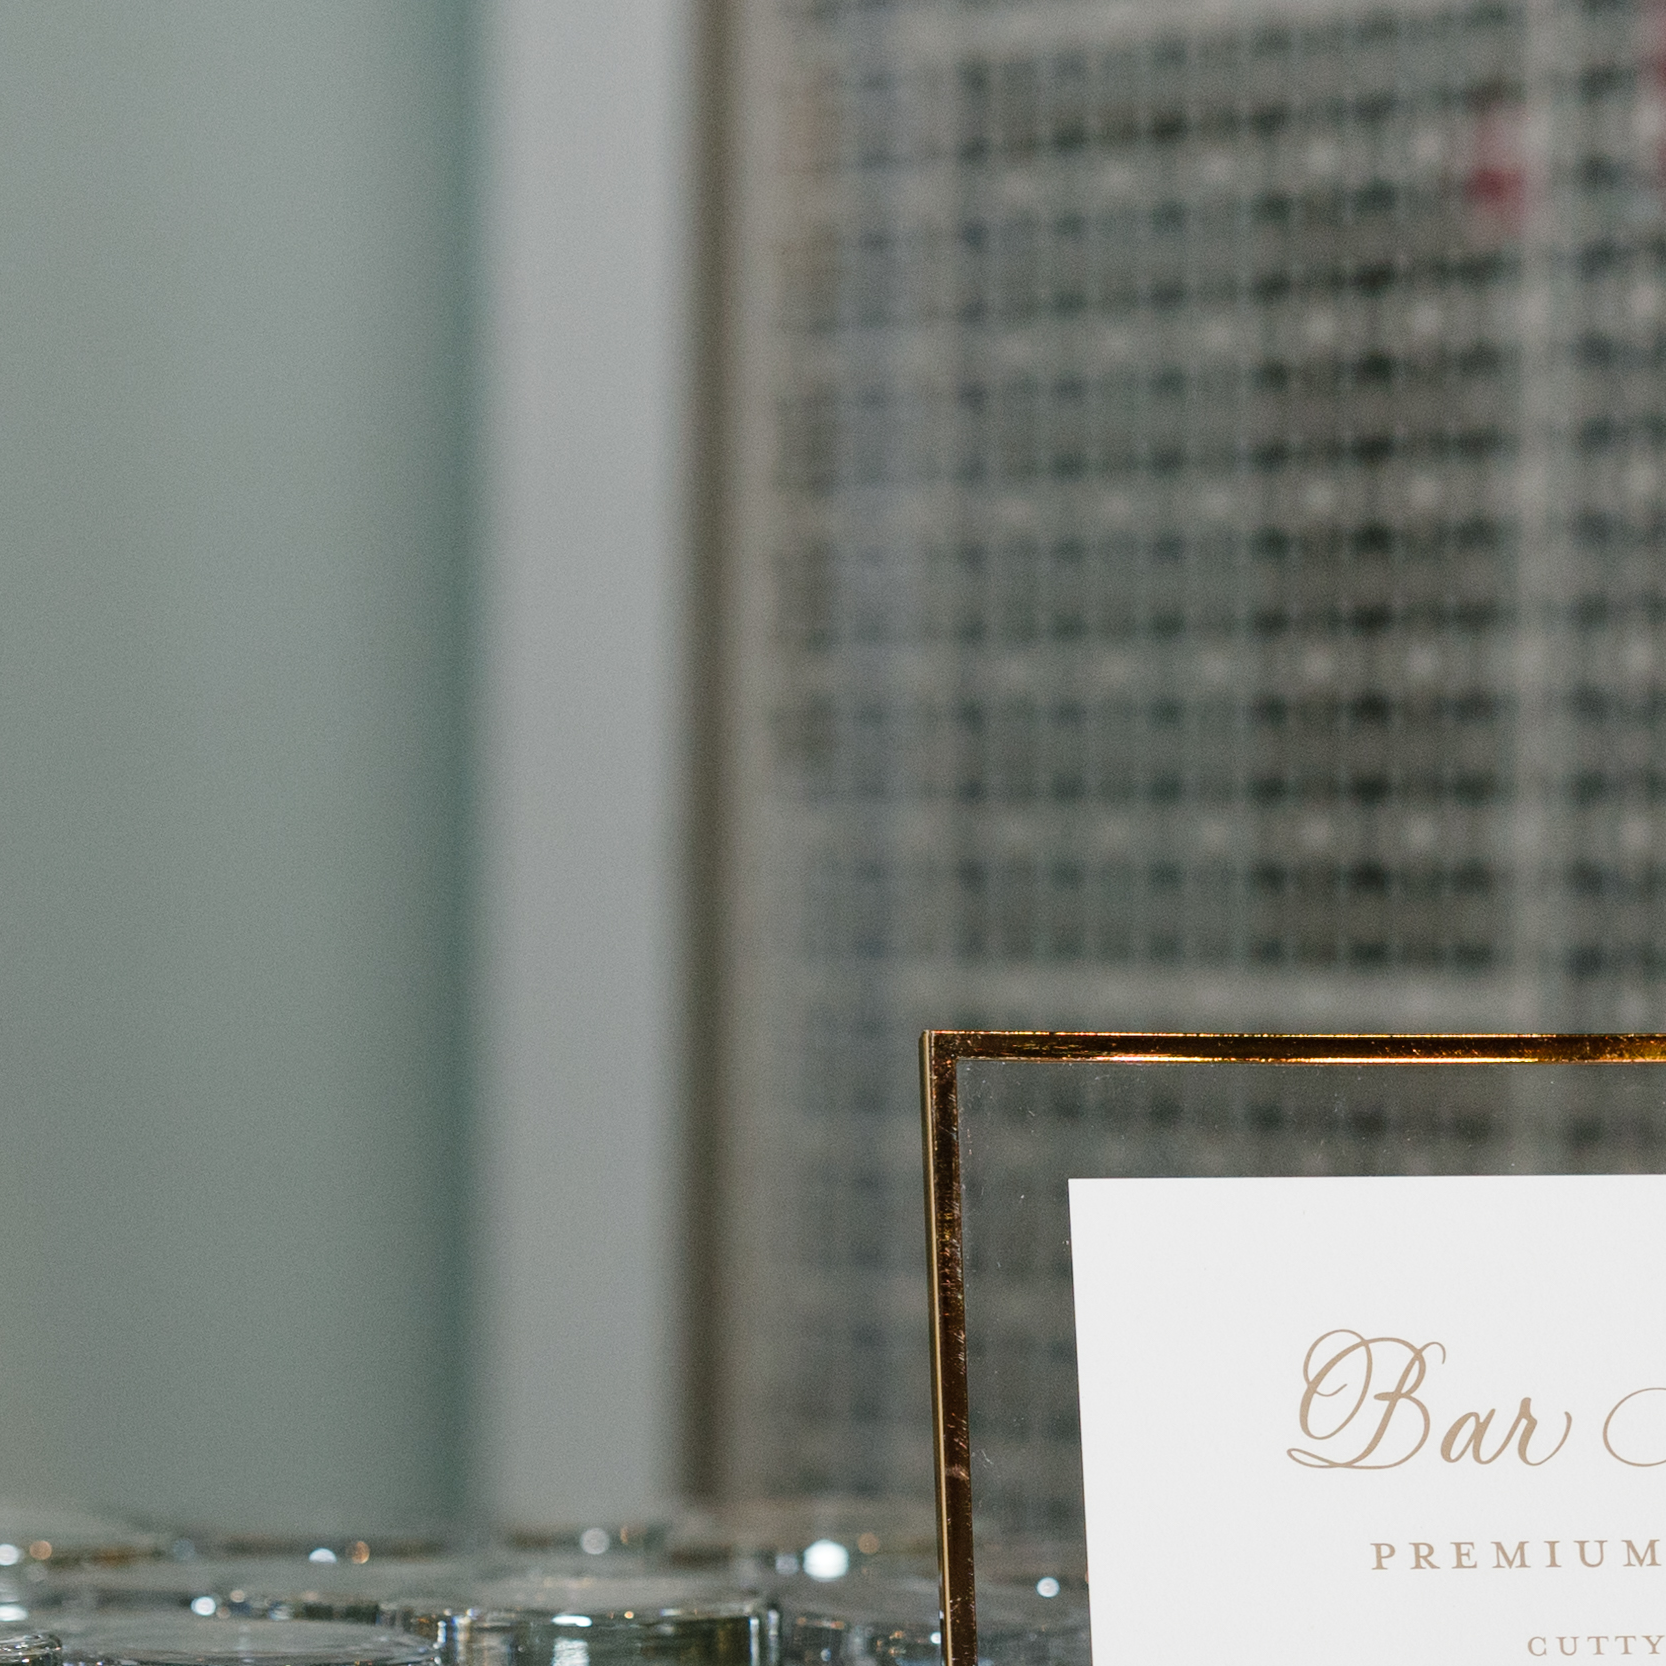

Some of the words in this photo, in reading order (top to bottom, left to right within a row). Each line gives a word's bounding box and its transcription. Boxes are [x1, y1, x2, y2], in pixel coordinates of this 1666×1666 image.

[1286, 1328, 1573, 1471] Bar
[1370, 1538, 1662, 1571] PREMIUM
[1527, 1634, 1665, 1657] CUTTY
